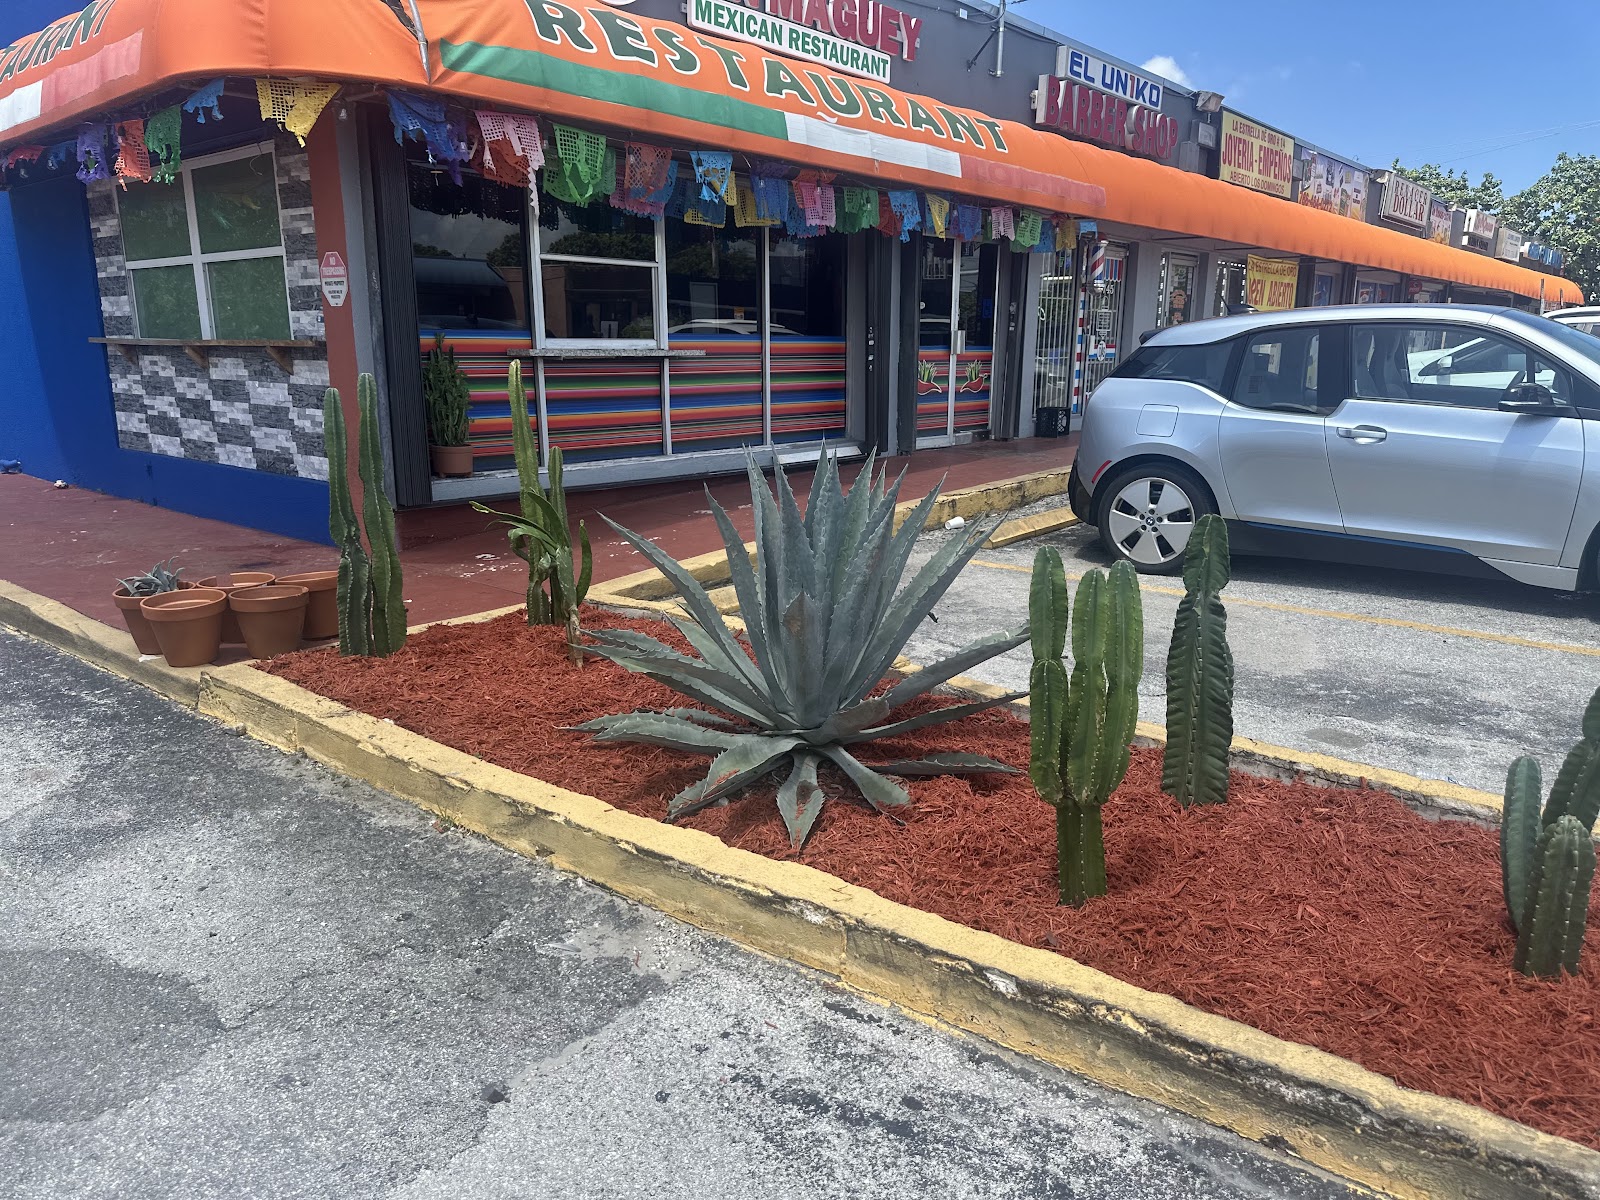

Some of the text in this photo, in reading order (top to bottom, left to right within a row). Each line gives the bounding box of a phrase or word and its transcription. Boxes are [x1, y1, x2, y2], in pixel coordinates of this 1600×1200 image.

[695, 0, 889, 79] MEXICAN RESTAURANT
[524, 0, 1008, 153] RESTAURANT
[1070, 50, 1095, 84] EL
[1044, 74, 1179, 160] BARBER SHOP
[1232, 119, 1239, 133] LA
[1239, 122, 1261, 140] ESTRELLA
[1267, 132, 1277, 146] ORO
[1280, 137, 1286, 149] 14
[1222, 132, 1254, 173] JOYERIA
[1258, 144, 1292, 184] EMPEÑOS
[1230, 171, 1285, 195] ABIERTO LOS DOMINGOS
[1392, 194, 1425, 222] DOLLAR
[1255, 262, 1279, 275] ESTRELLA
[1280, 265, 1287, 277] DE
[1287, 266, 1297, 278] ORO
[1267, 280, 1294, 309] ABIERTO
